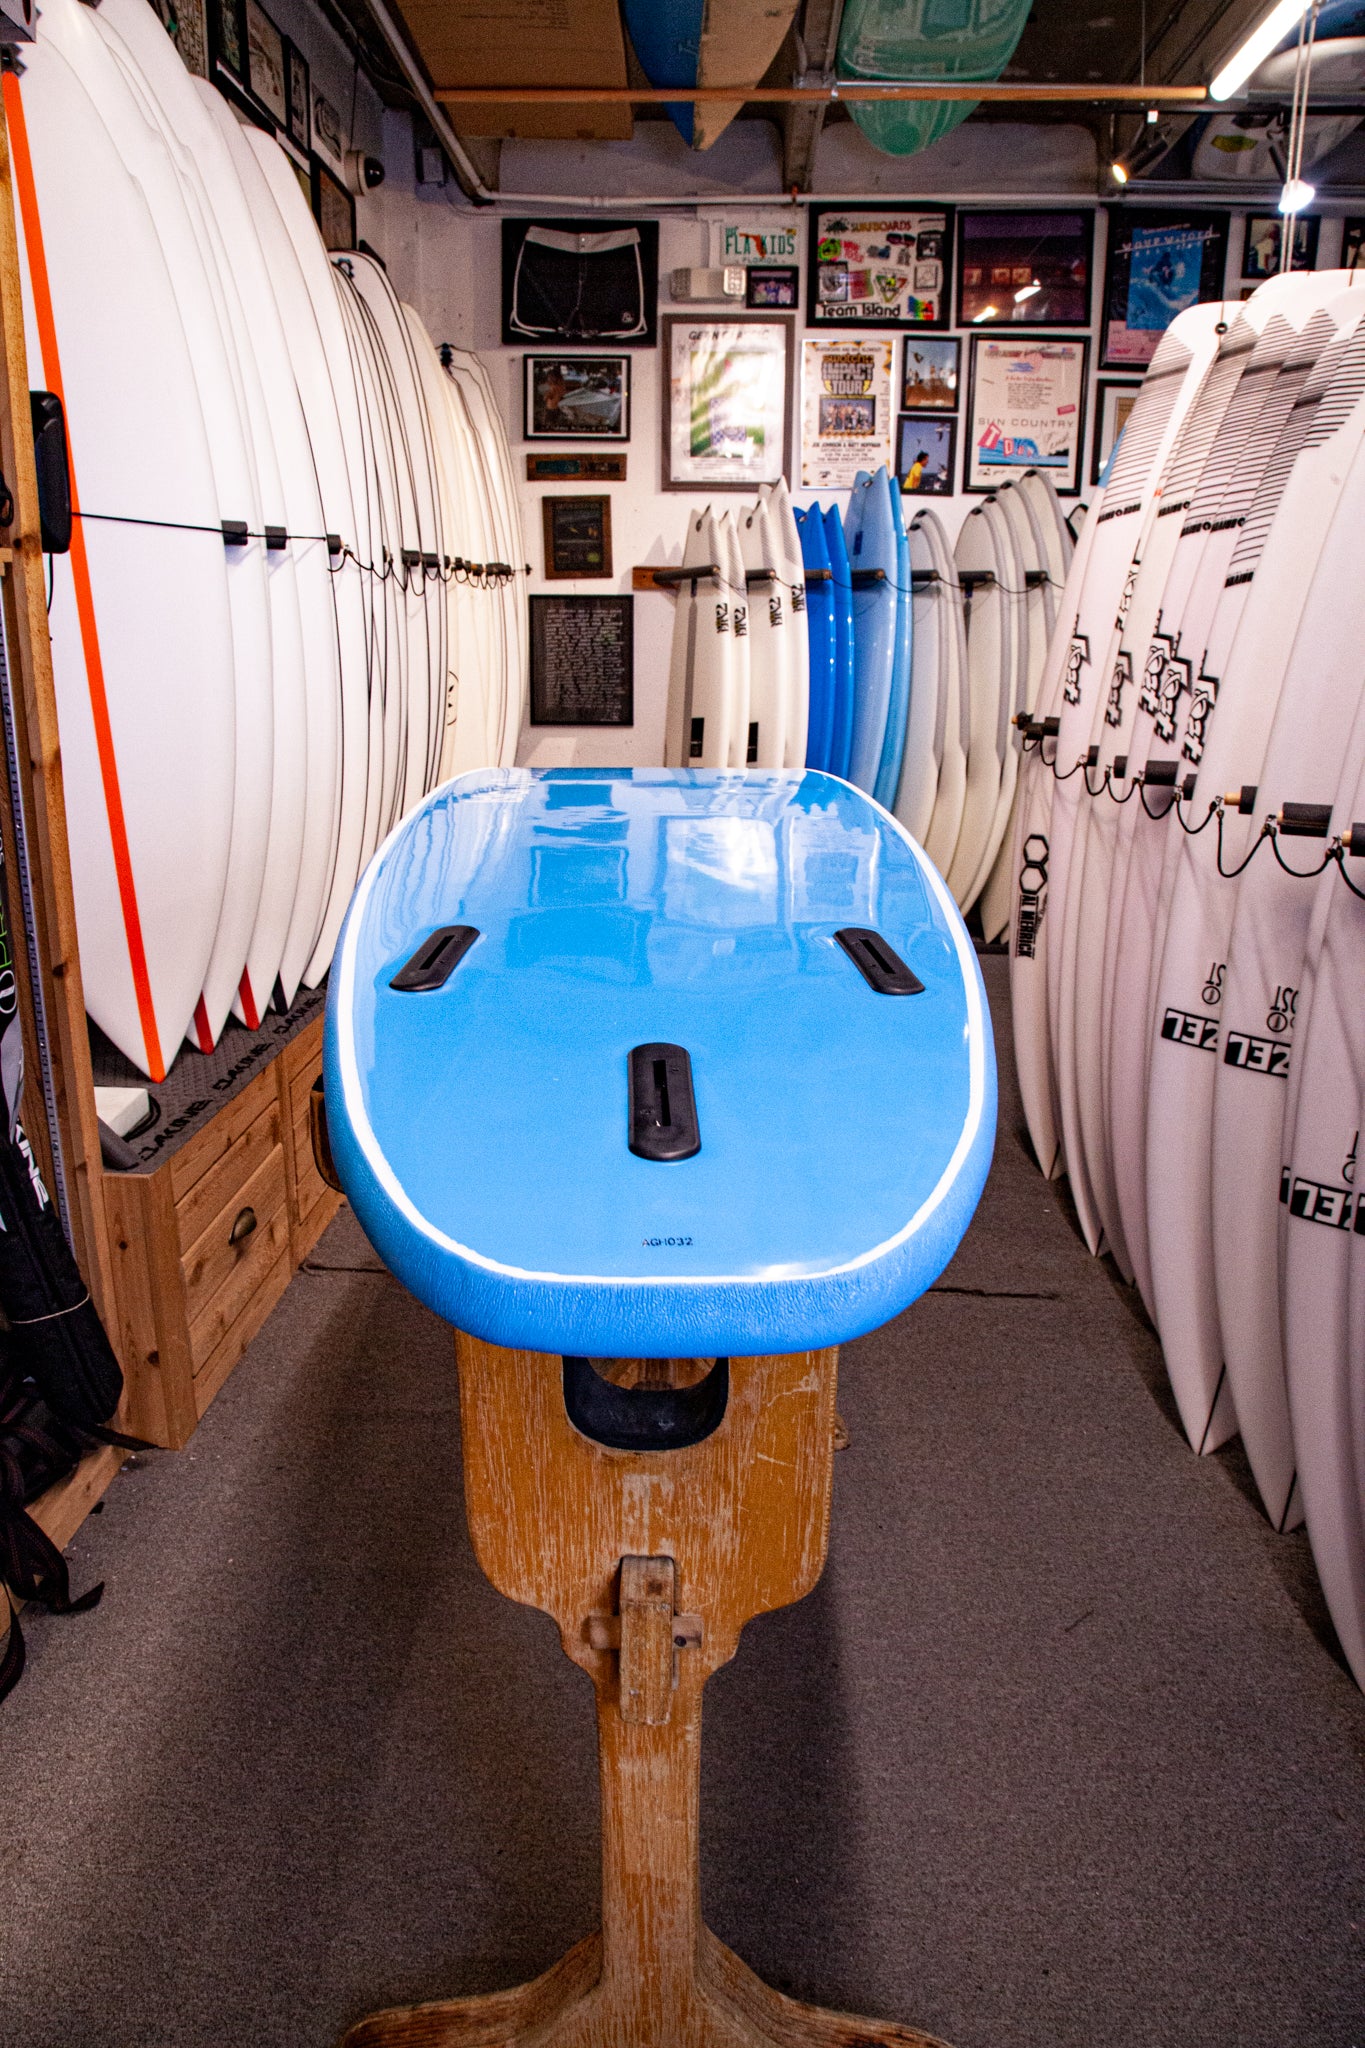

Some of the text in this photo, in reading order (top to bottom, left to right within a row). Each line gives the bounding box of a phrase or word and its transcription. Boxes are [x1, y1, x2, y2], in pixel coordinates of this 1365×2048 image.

[851, 220, 912, 233] SURFBOARDS
[725, 234, 796, 255] FLA KIDS
[820, 304, 902, 318] Team Island
[822, 362, 874, 380] IMPACT
[832, 380, 863, 395] TOUR
[978, 417, 1074, 428] SUN COUNTRY
[1017, 895, 1036, 958] AL MERRICK
[271, 997, 322, 1035] DAKINE
[212, 1042, 276, 1091] DAKINE
[137, 1099, 214, 1162] DAKINE
